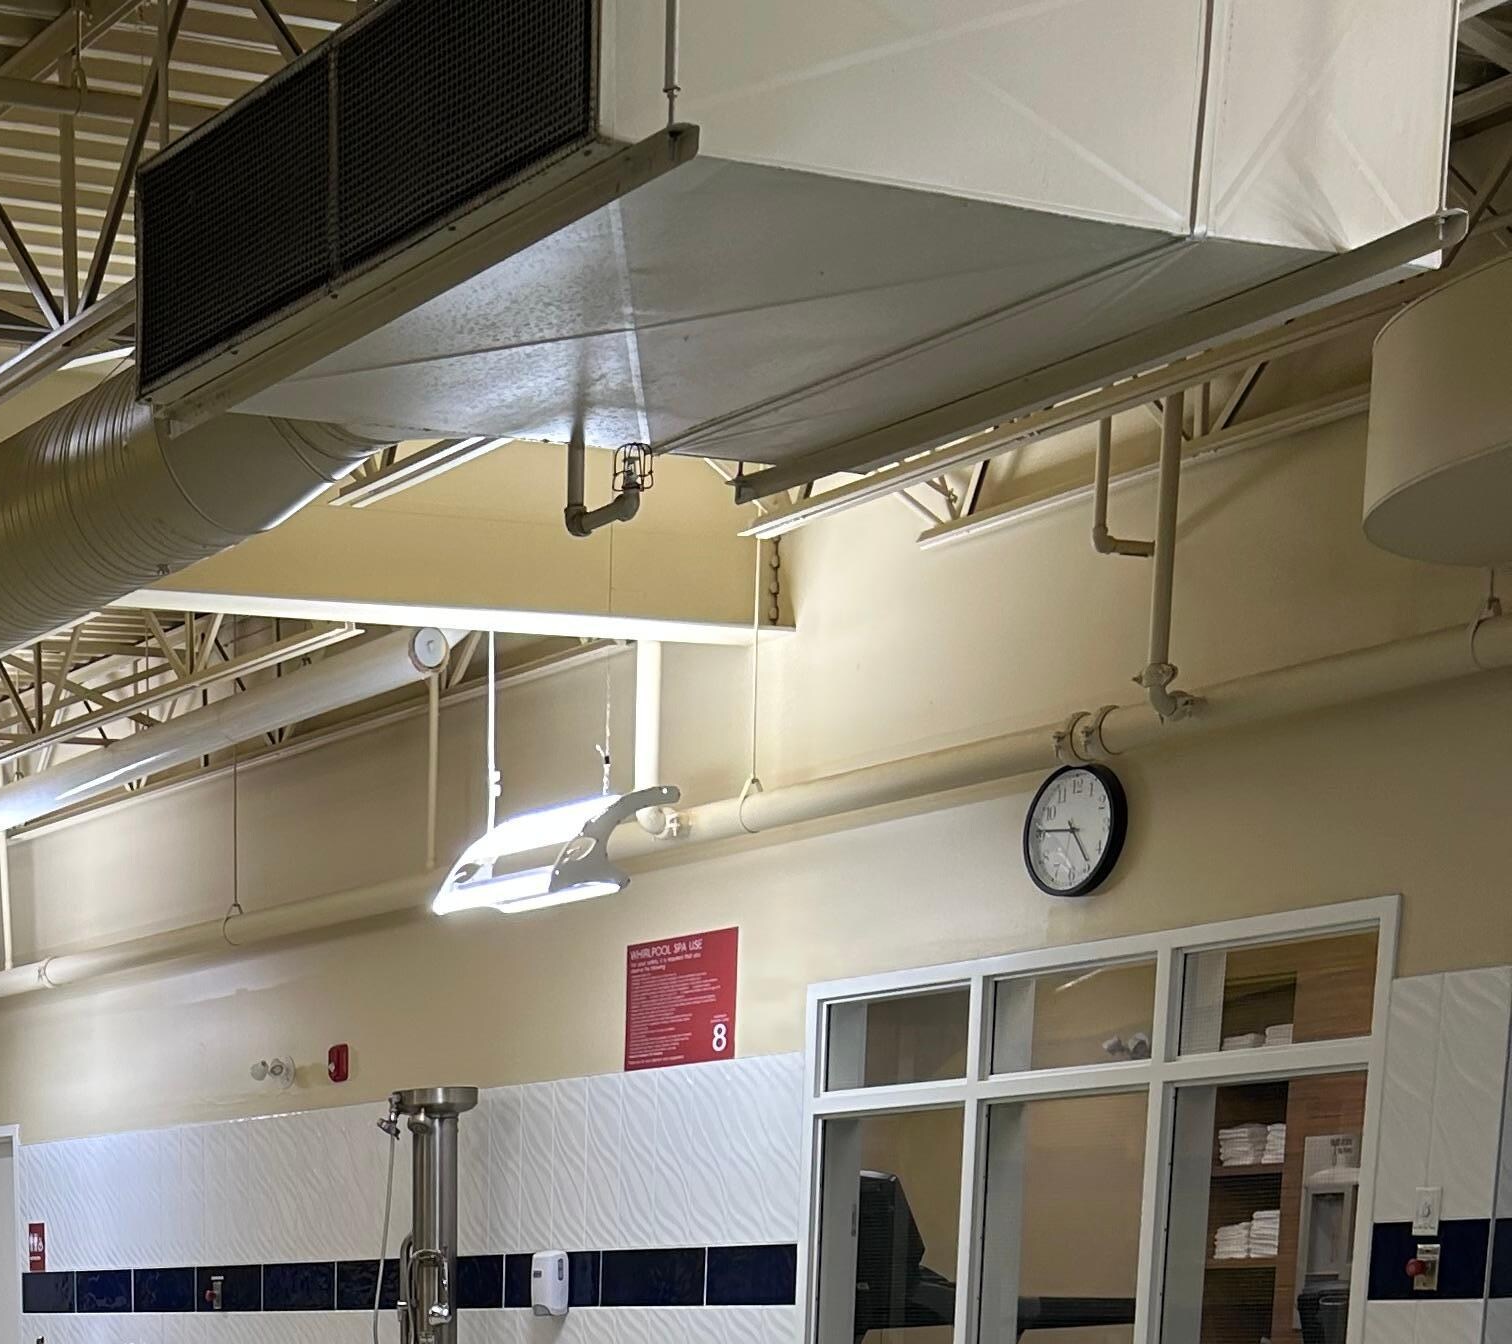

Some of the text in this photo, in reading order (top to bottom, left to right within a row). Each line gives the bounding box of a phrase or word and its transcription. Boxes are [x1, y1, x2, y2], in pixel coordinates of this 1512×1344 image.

[1072, 779, 1083, 794] 12
[1098, 794, 1106, 810] 2
[1046, 805, 1056, 820] 10
[630, 945, 671, 960] WHIRLPOOL
[673, 942, 687, 954] SPA
[688, 939, 703, 951] USE
[712, 1023, 727, 1052] 8
